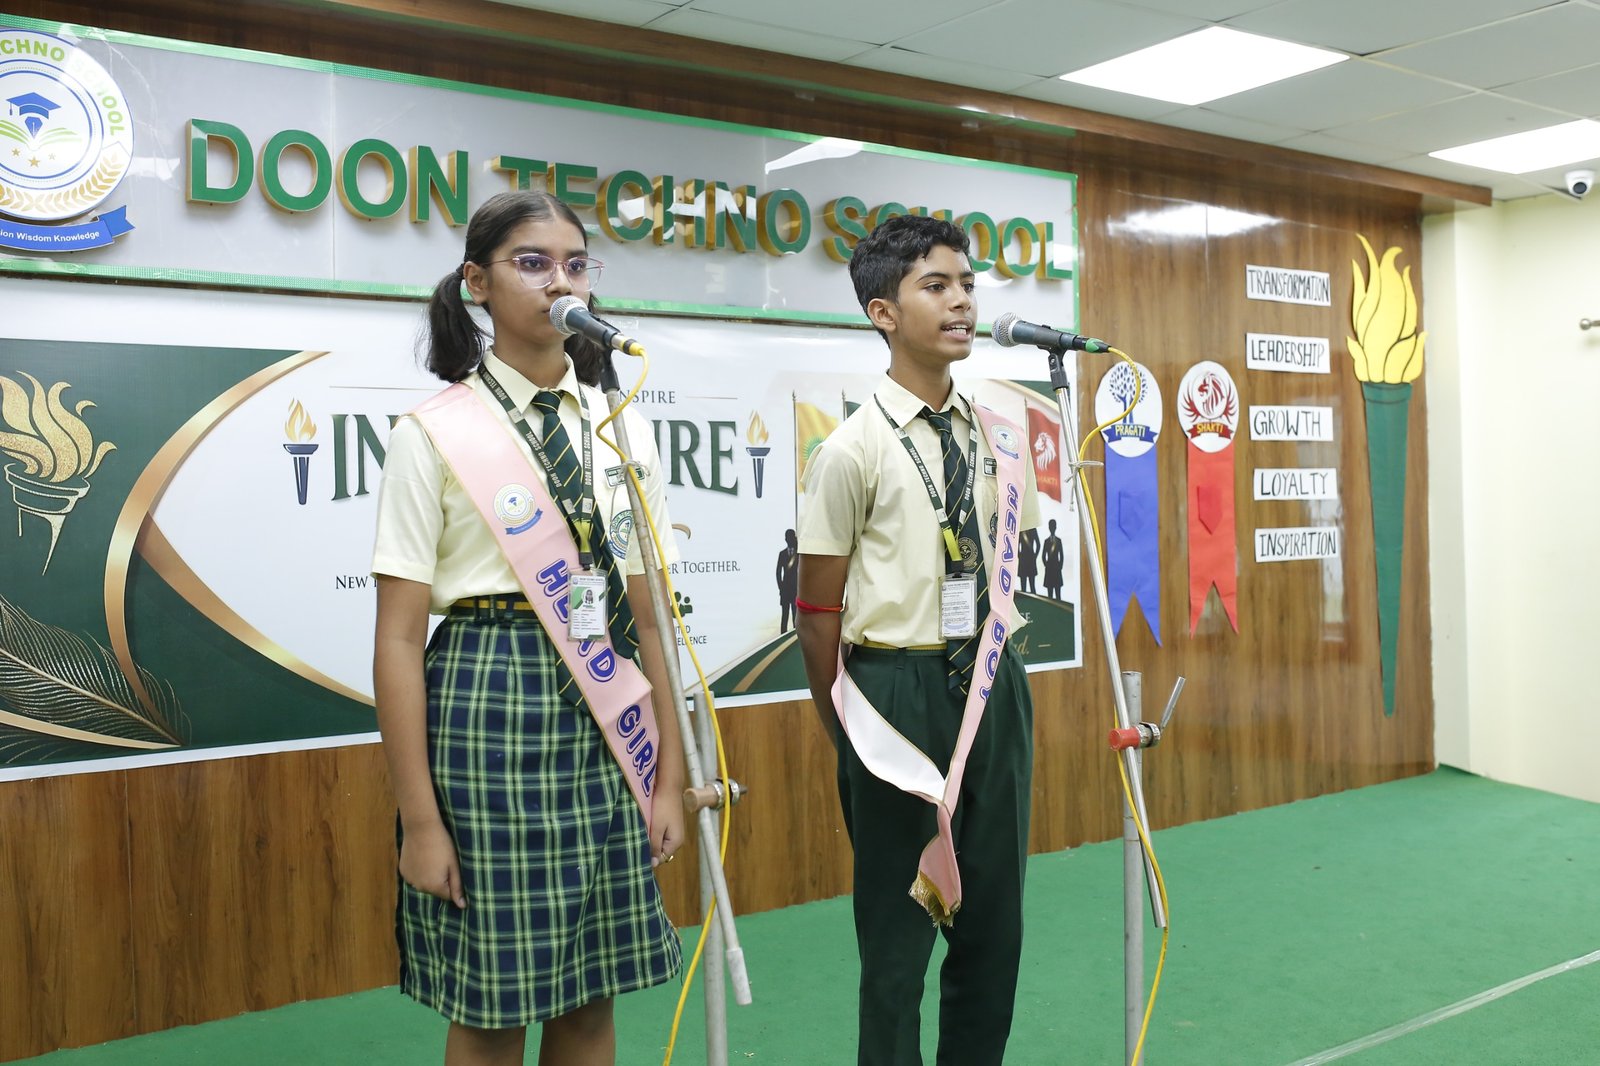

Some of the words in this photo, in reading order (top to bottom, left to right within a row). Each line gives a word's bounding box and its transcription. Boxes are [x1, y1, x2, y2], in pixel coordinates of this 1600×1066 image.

[0, 39, 65, 62] CHNO
[185, 118, 468, 227] DOON
[823, 196, 1073, 281] SOOL
[0, 229, 14, 239] ion
[16, 232, 52, 243] Wisdom
[53, 230, 100, 242] Knowledge
[1248, 269, 1330, 303] TRANSFORMATION
[1251, 338, 1326, 368] LEADERSHIP
[619, 389, 676, 404] NSPIRE
[1115, 424, 1146, 437] PRAGATI
[1196, 423, 1224, 434] SHAKTI
[1253, 409, 1322, 438] GROWTH
[1260, 472, 1329, 497] LOYALTY
[998, 482, 1020, 597] HEAD
[1259, 531, 1337, 557] INSPIRATION
[681, 560, 741, 575] TOGETHER.
[335, 575, 368, 590] NEW
